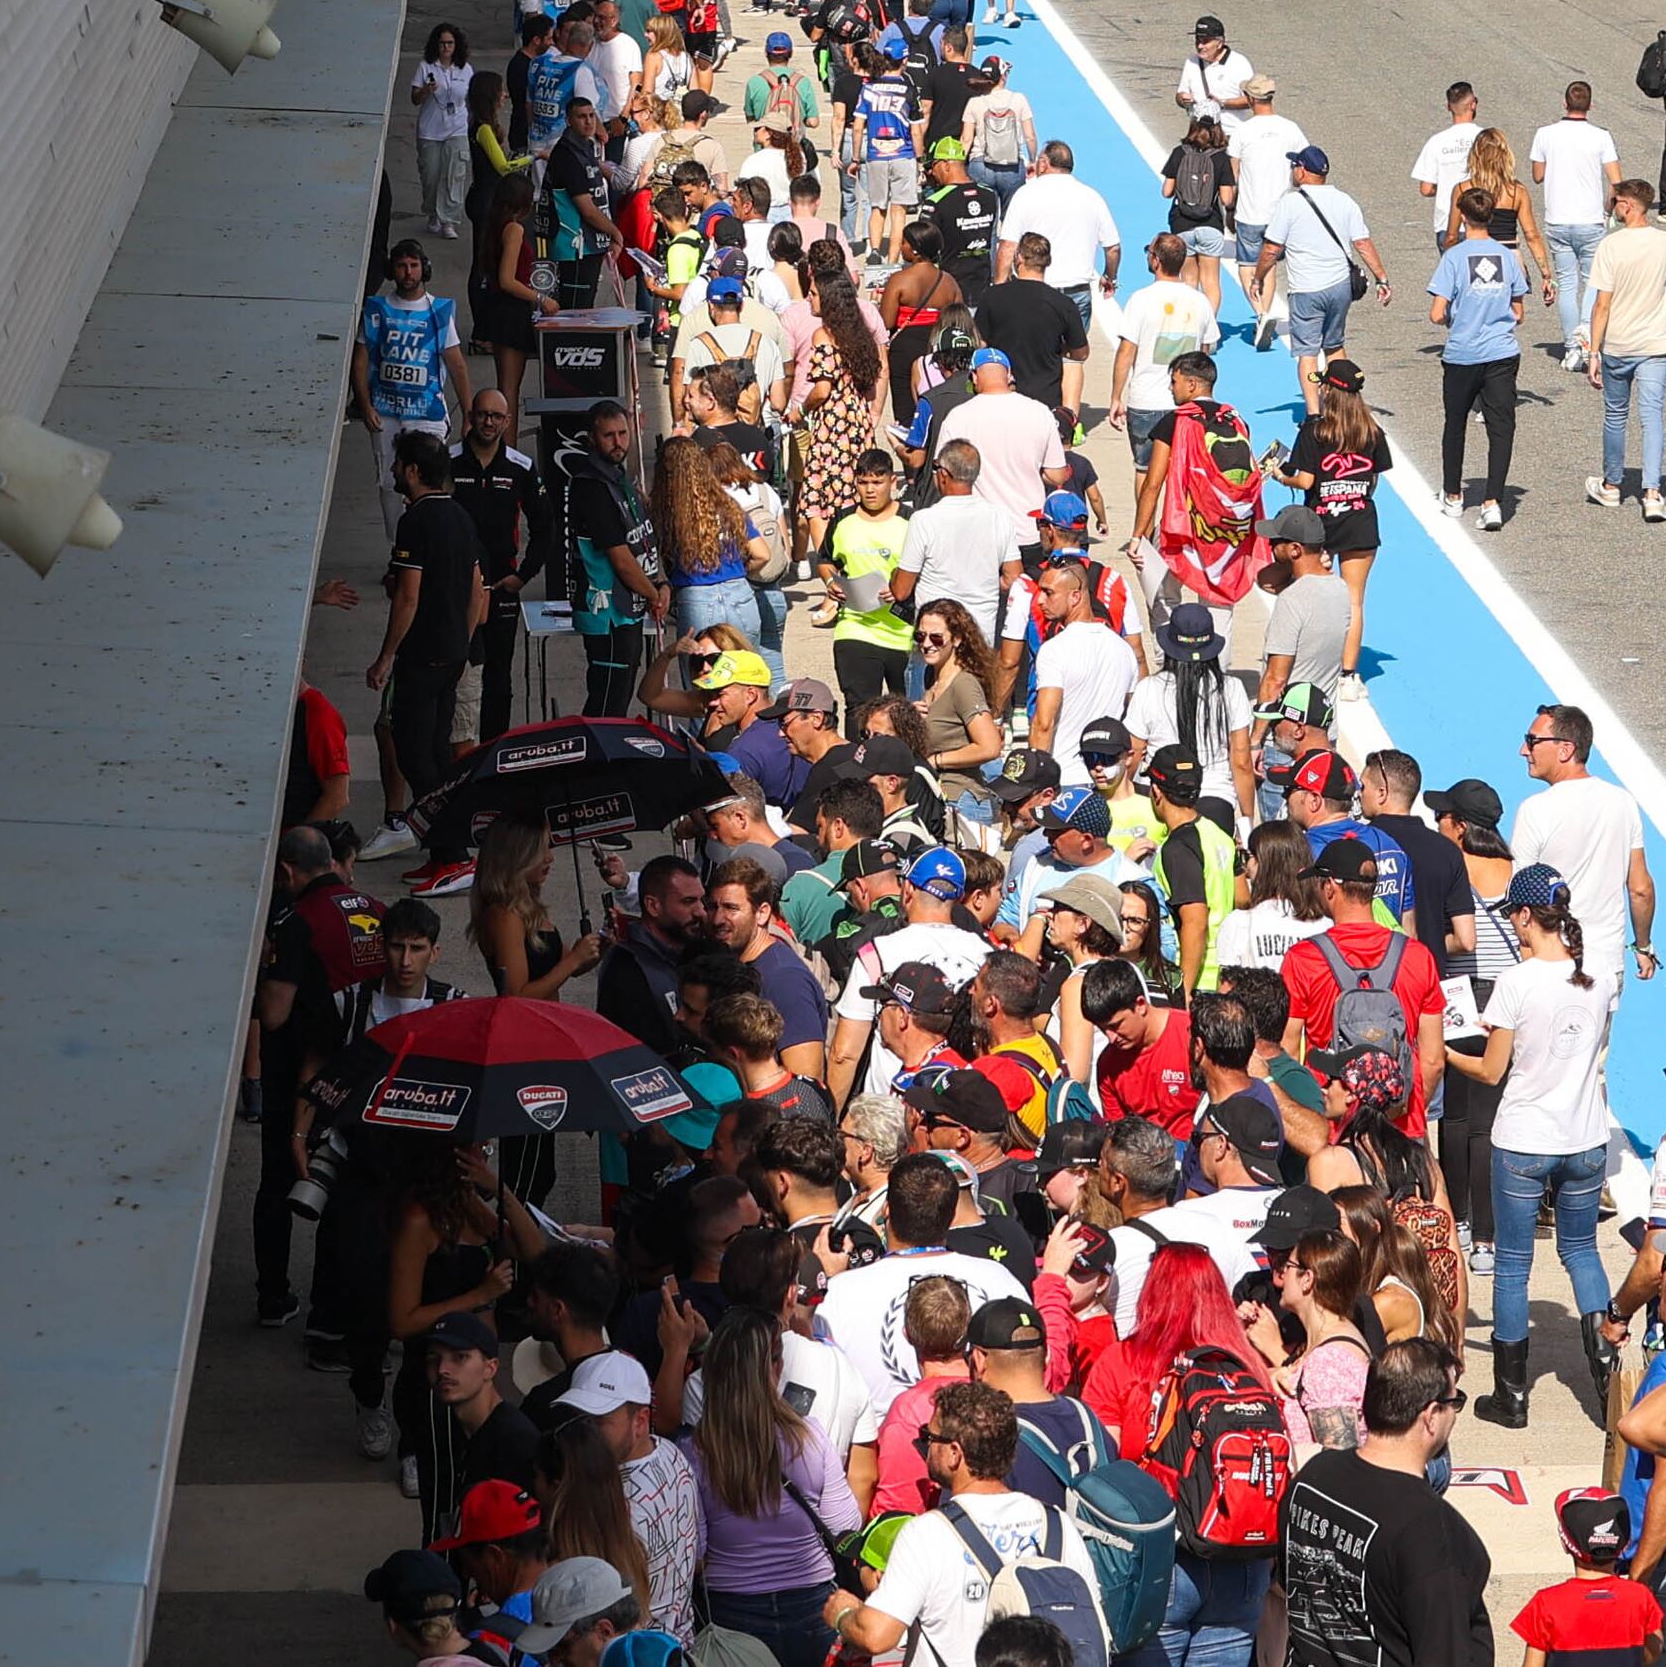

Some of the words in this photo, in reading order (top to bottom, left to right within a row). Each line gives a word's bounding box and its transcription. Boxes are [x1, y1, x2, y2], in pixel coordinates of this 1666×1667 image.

[537, 89, 563, 100] ANE
[387, 331, 425, 344] PIT
[384, 365, 421, 384] 0381
[508, 740, 574, 761] aruba.it
[383, 1085, 457, 1106] aruba.it
[523, 1091, 561, 1100] DUCATI
[1233, 1219, 1265, 1229] BoxMo
